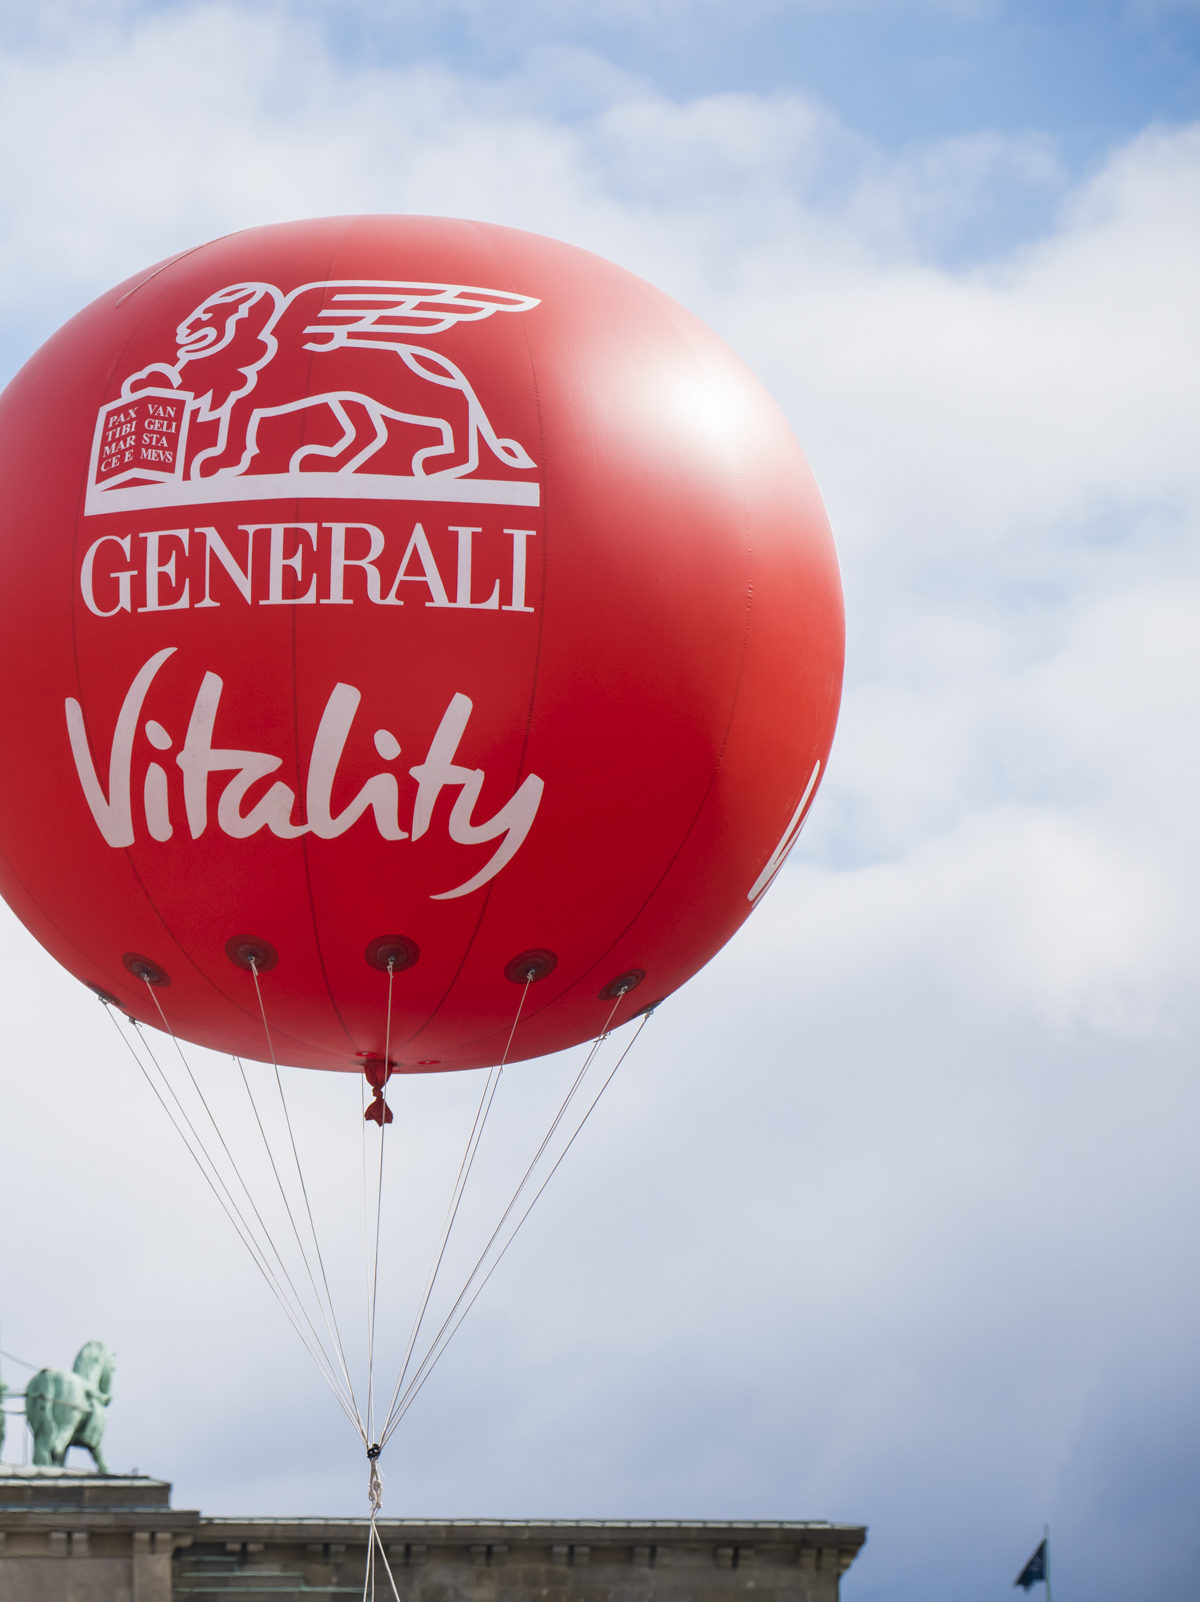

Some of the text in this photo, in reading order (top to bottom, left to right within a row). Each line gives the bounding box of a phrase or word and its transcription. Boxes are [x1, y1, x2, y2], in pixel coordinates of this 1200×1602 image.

[108, 407, 138, 428] PAX
[148, 405, 176, 418] VAN
[106, 421, 137, 442] TIBI
[145, 419, 177, 433] GELI
[103, 436, 135, 458] MAR
[142, 434, 168, 447] STA
[101, 450, 134, 472] CE E
[140, 448, 173, 463] MEVS
[80, 522, 537, 617] GENERALI
[65, 647, 545, 900] Vitality
